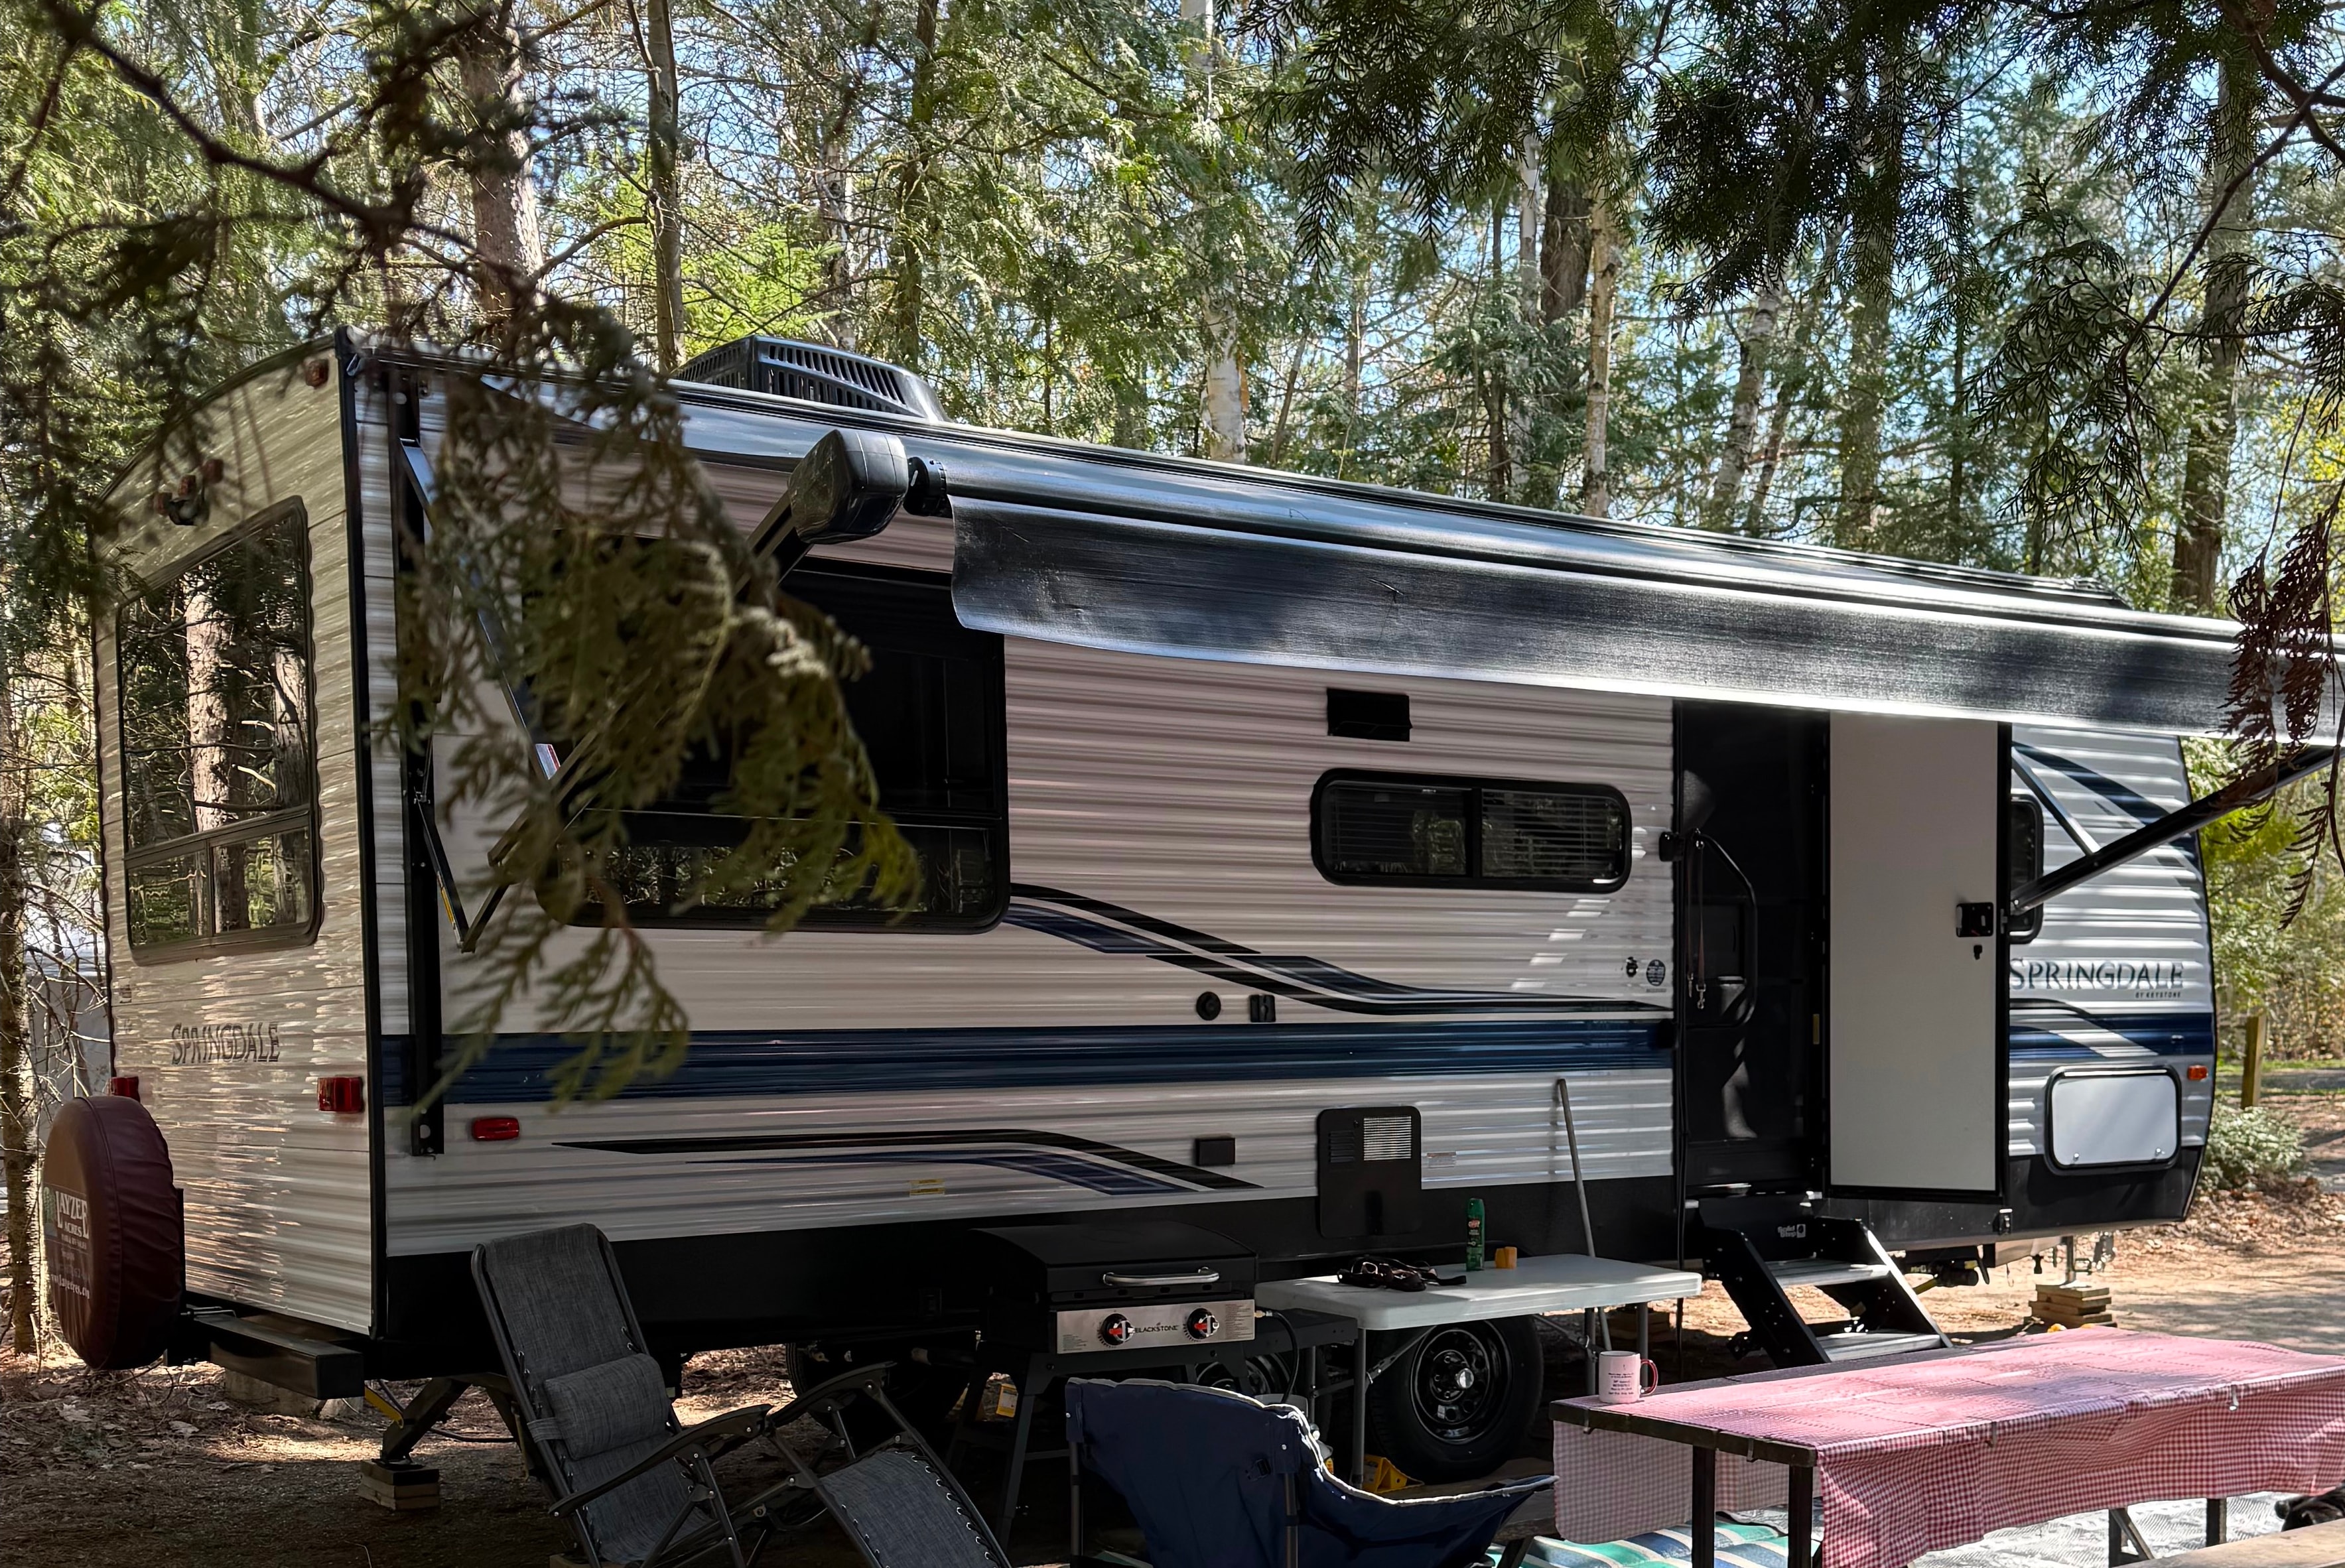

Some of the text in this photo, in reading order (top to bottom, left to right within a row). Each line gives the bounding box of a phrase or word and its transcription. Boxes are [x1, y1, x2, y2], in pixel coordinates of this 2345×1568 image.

[2010, 958, 2184, 990] SPRINGDALE
[171, 1022, 280, 1064] SPRINGDALE
[55, 1191, 90, 1240] LAYZEE
[64, 1222, 82, 1237] ACRES
